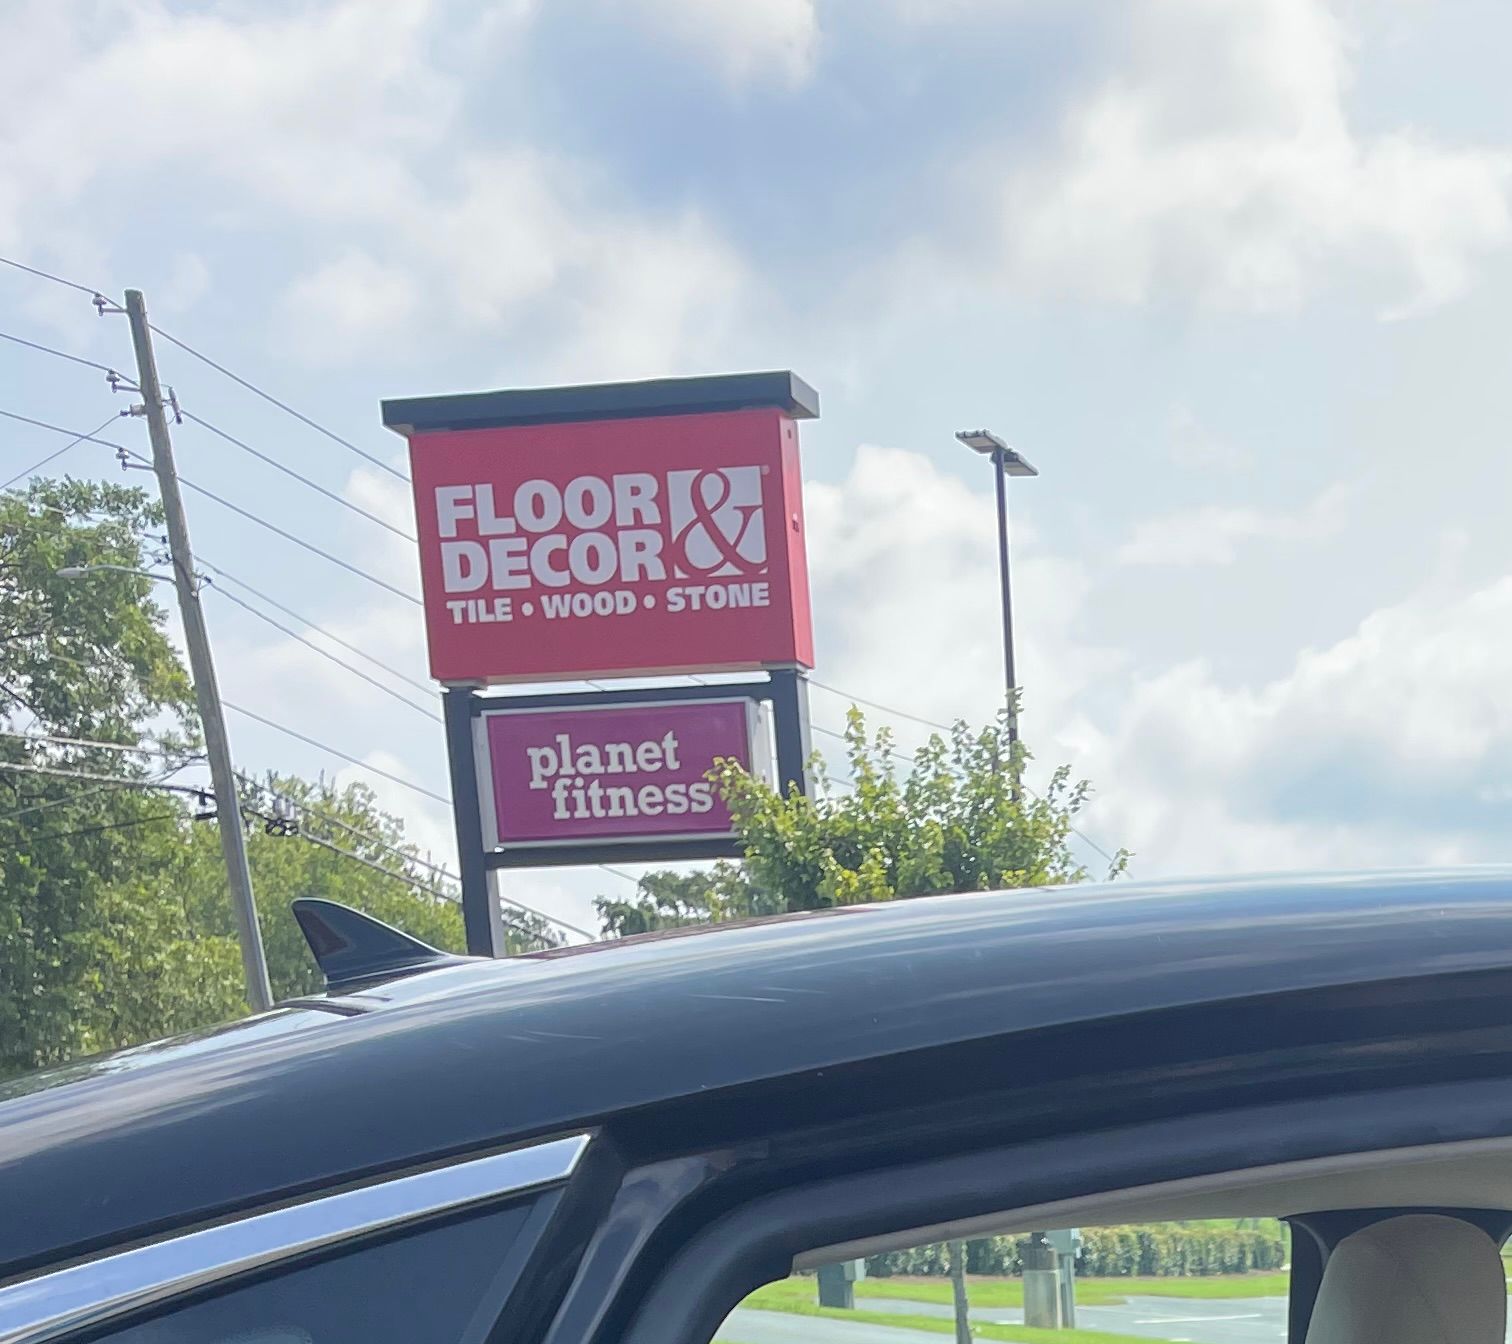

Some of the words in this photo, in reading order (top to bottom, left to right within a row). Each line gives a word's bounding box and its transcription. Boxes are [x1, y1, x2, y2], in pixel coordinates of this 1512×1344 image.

[434, 472, 662, 538] FLOOR
[667, 466, 768, 578] &
[440, 528, 667, 593] DECOR
[446, 597, 513, 625] TILE
[540, 590, 637, 620] WOOD
[666, 582, 770, 613] STONE
[526, 730, 681, 790] planet
[551, 776, 714, 820] fitness
